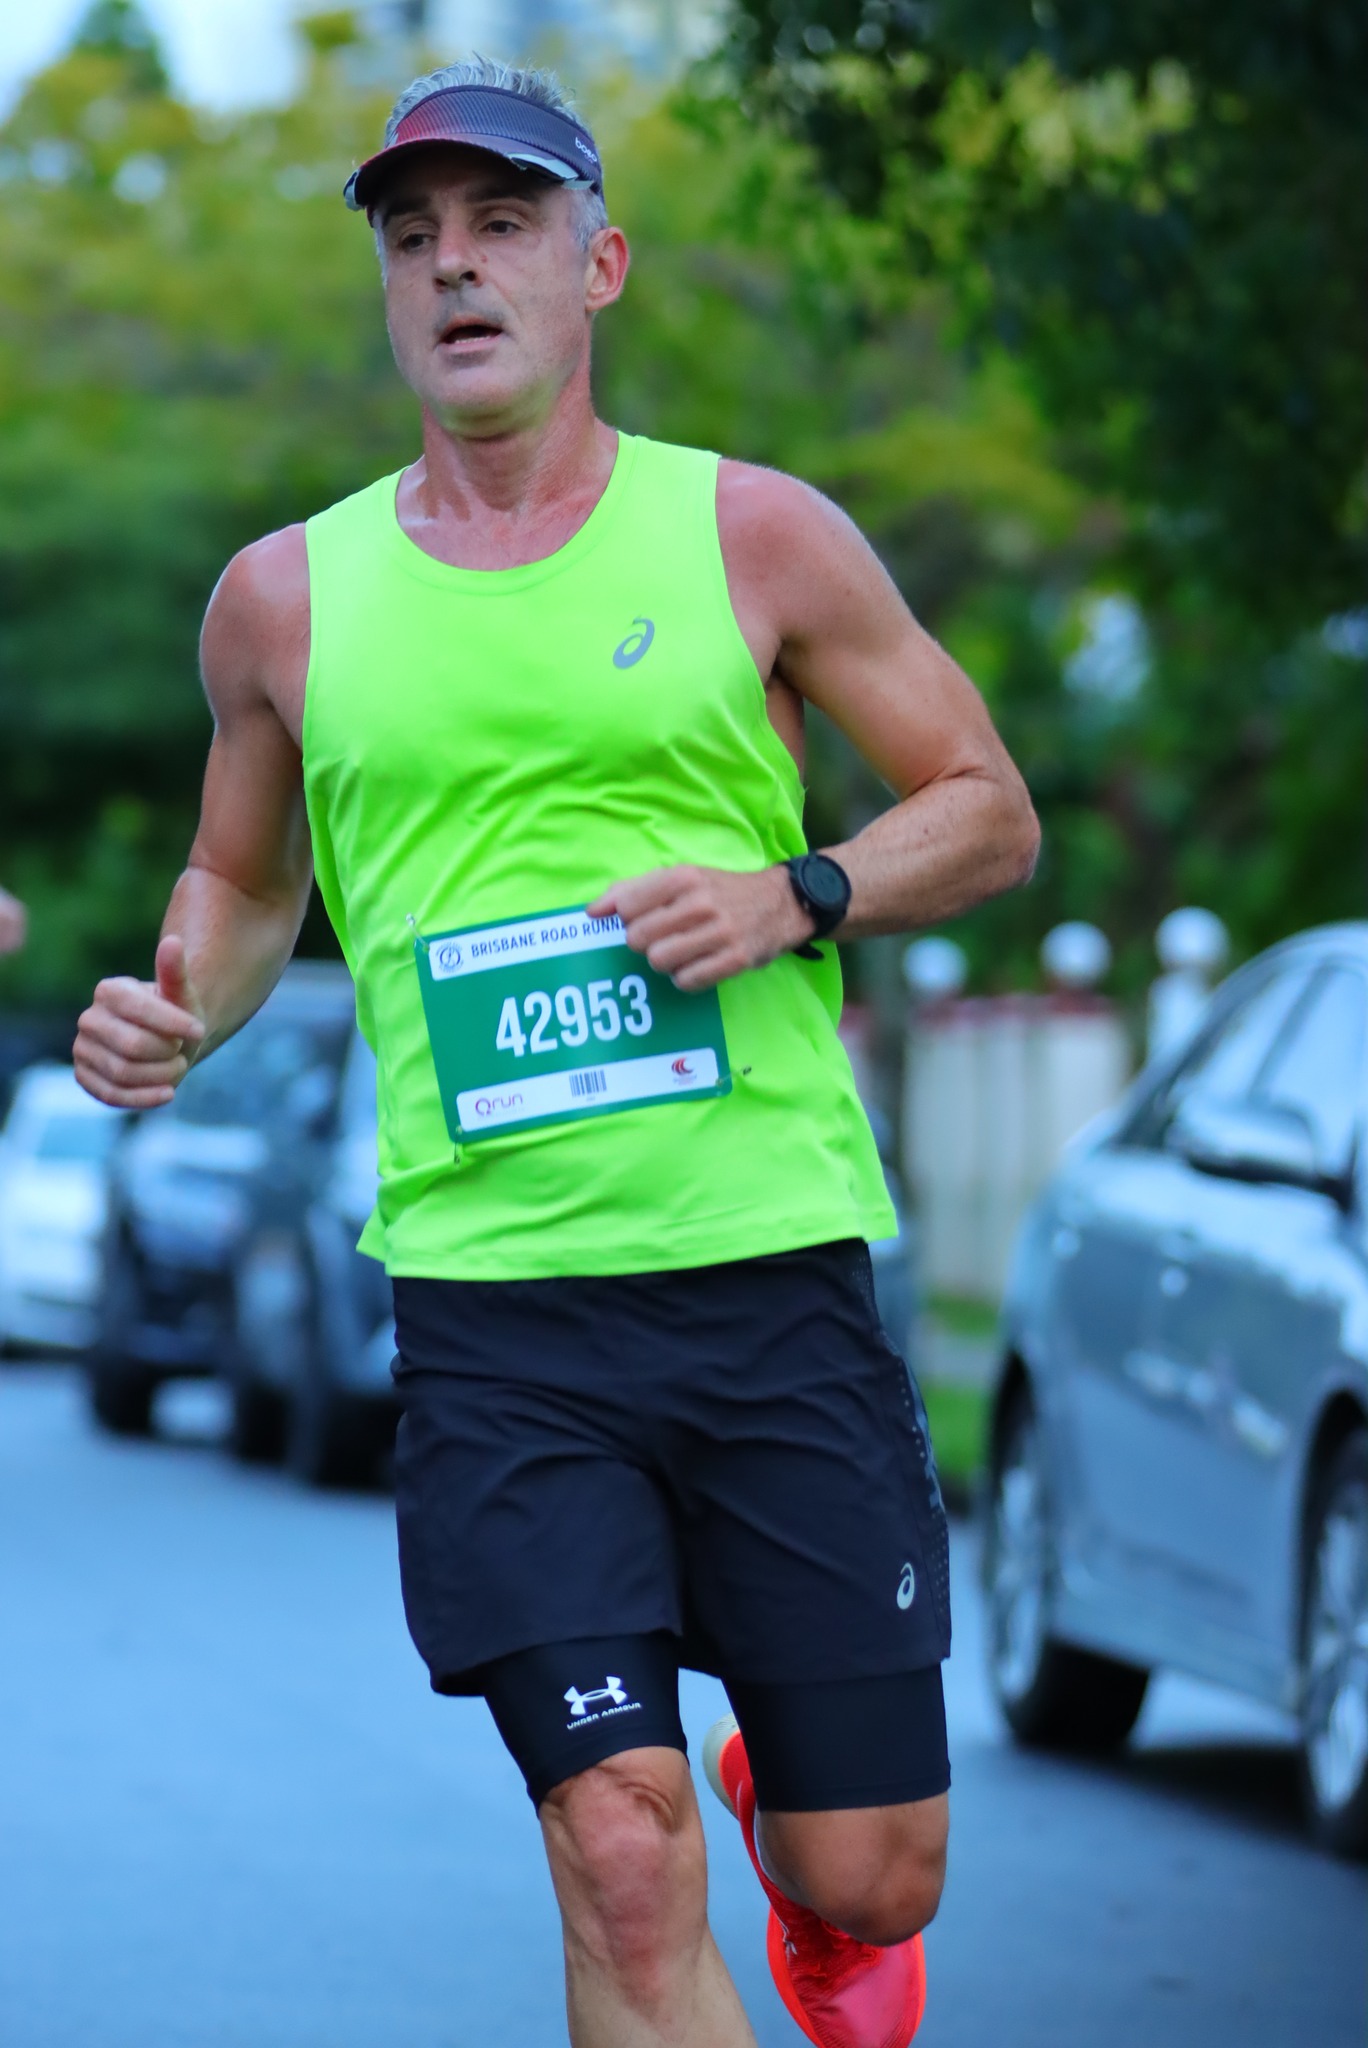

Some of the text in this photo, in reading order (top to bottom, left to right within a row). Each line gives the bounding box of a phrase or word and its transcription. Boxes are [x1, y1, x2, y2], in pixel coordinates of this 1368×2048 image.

[471, 931, 537, 958] BRISBANE
[541, 925, 578, 943] ROAD
[495, 974, 653, 1057] 42953
[566, 1702, 641, 1730] UNDER ARMOUR
